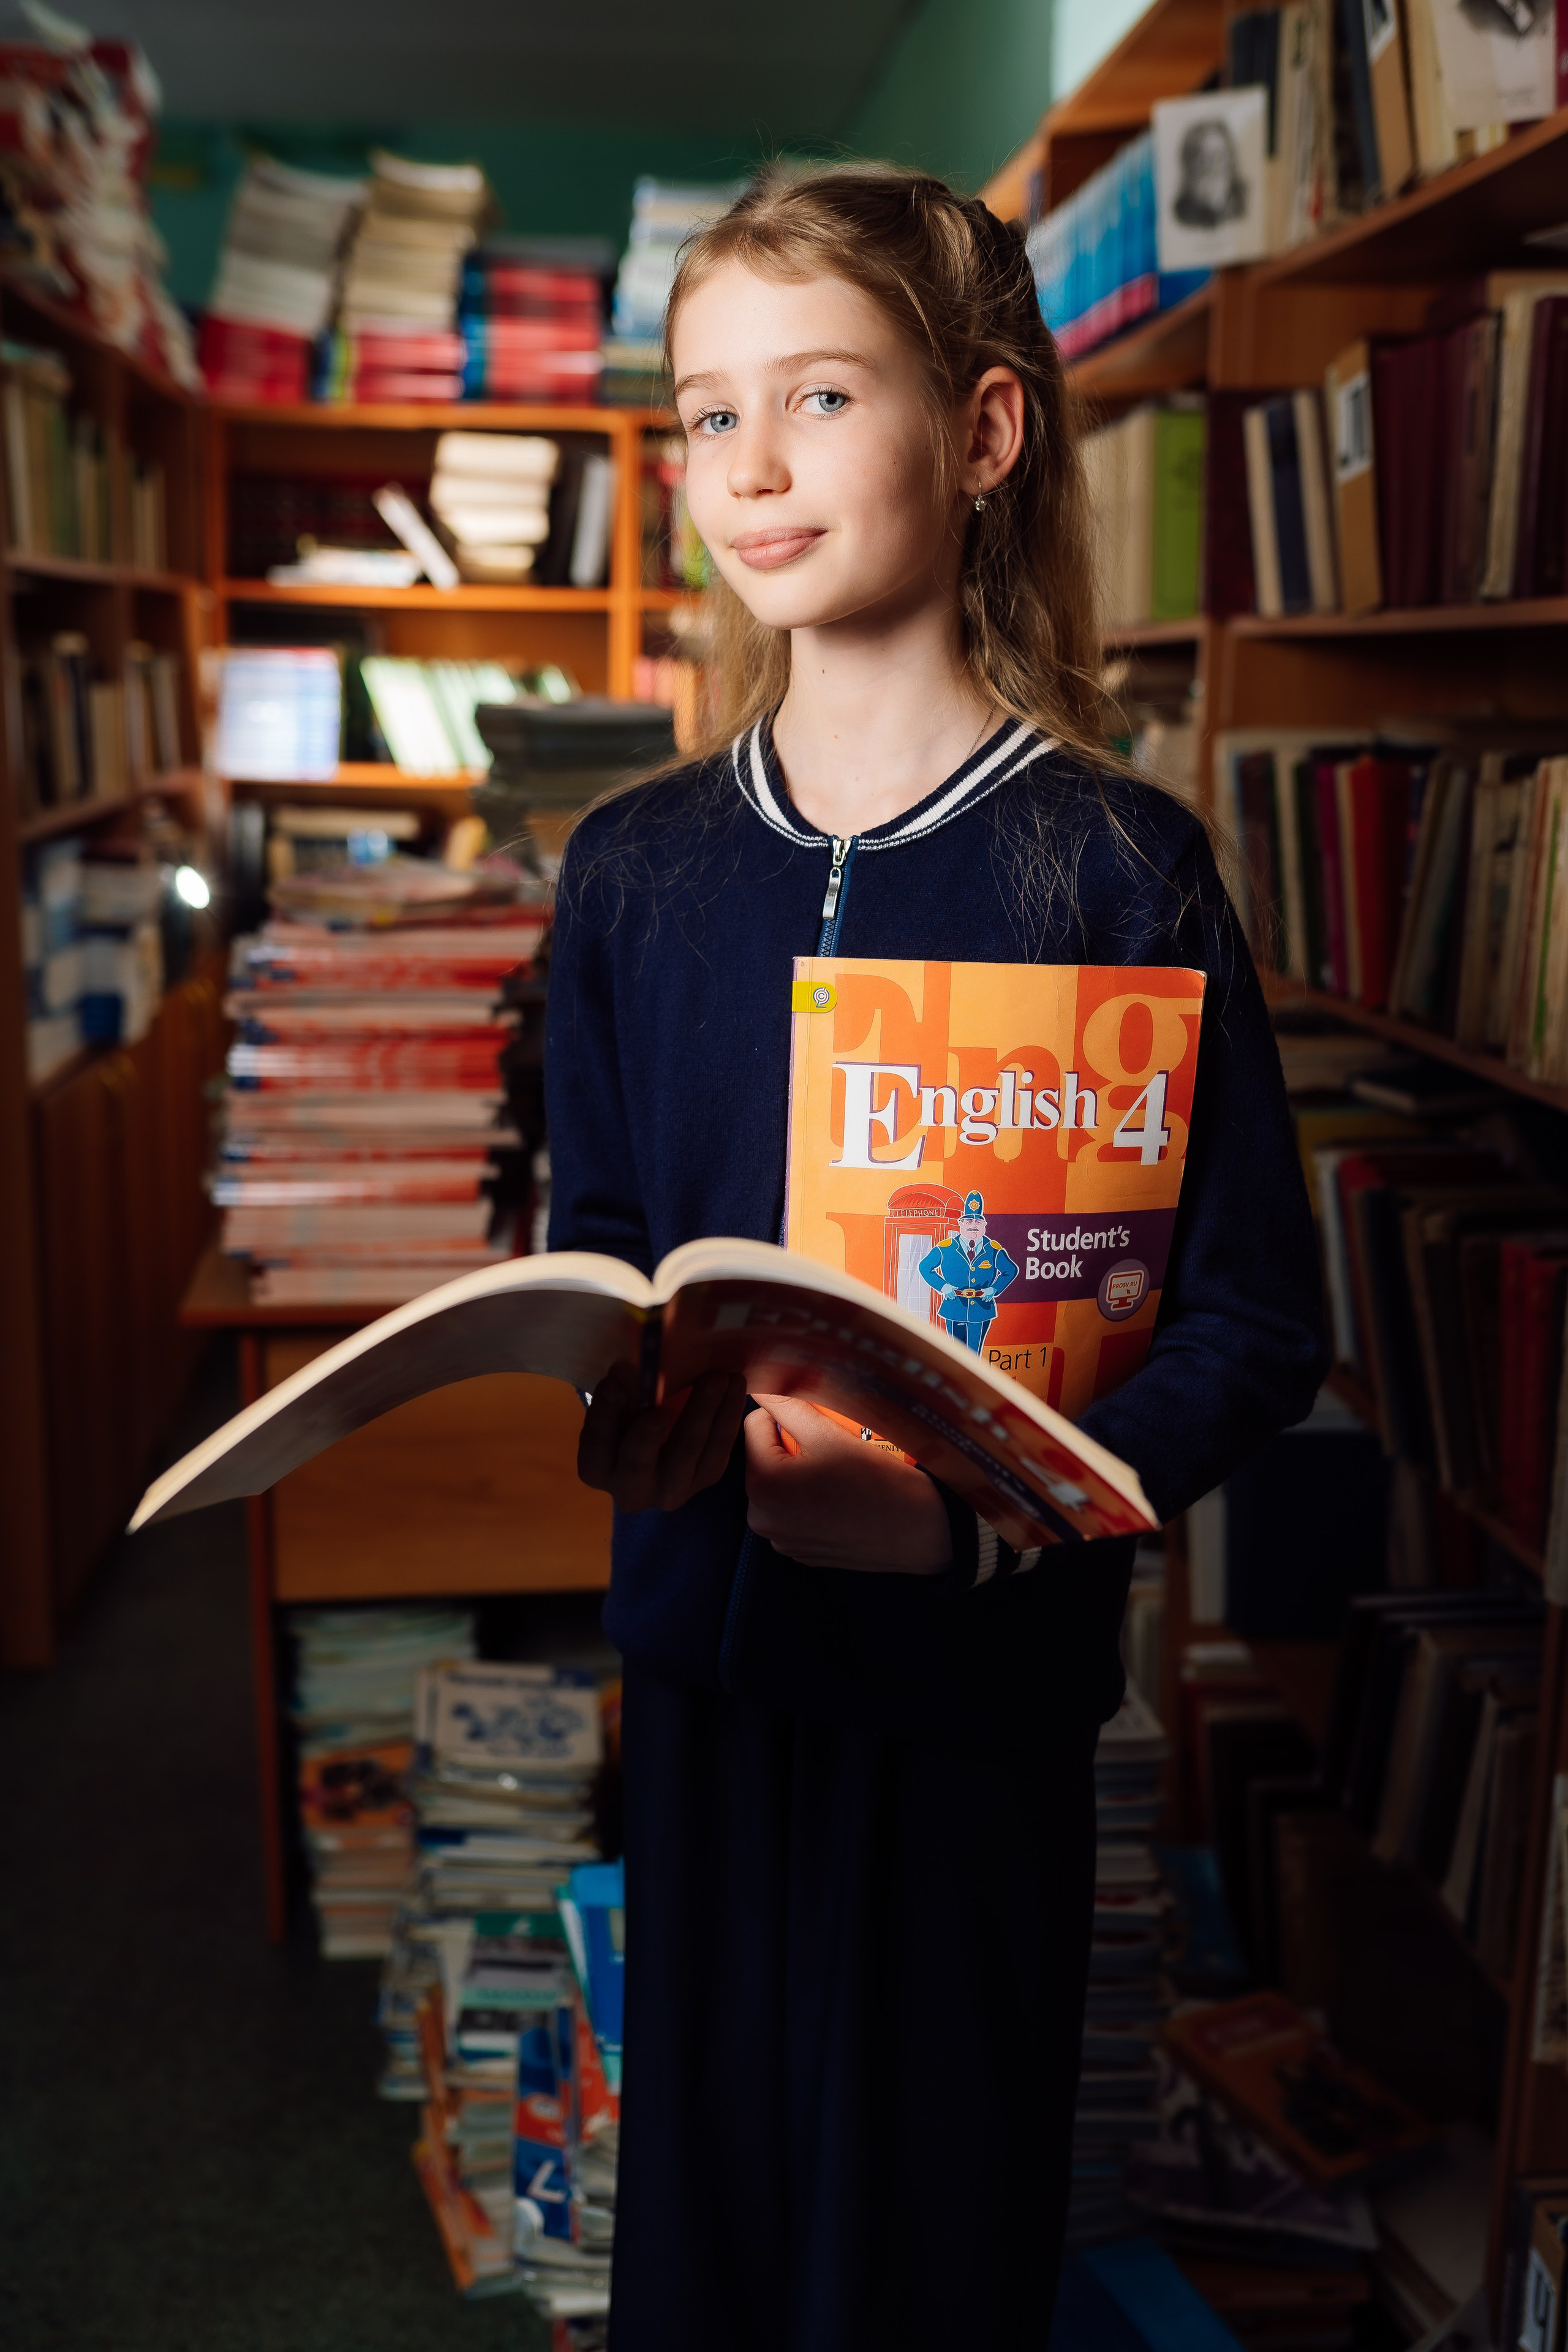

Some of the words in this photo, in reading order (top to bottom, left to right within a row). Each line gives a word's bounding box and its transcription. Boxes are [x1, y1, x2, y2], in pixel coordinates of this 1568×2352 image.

[829, 1061, 1100, 1170] English
[1112, 1069, 1172, 1166] 4
[894, 1209, 939, 1218] TELEPHONE
[1026, 1225, 1131, 1252] Student's
[1025, 1254, 1084, 1280] Book
[1112, 1280, 1138, 1289] PROSV.RU
[989, 1349, 1033, 1371] Part
[1039, 1346, 1047, 1368] 1
